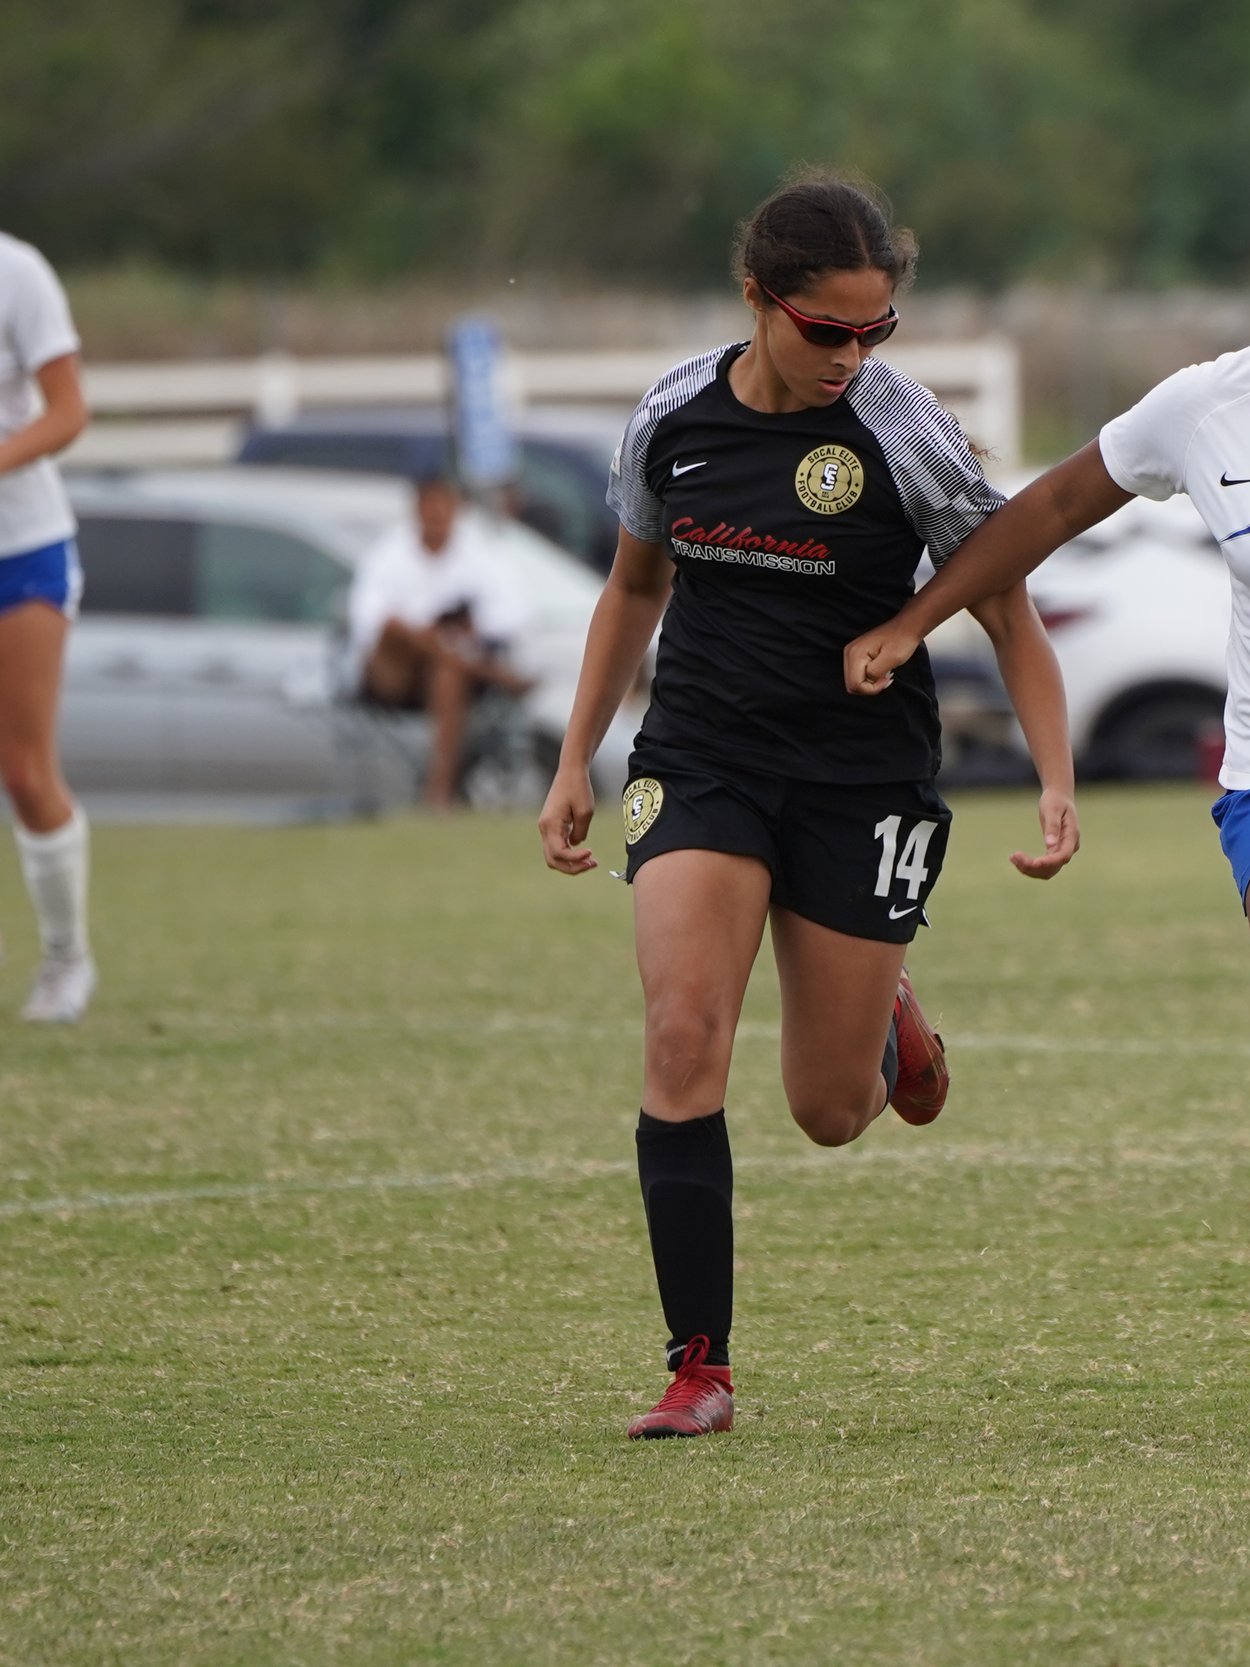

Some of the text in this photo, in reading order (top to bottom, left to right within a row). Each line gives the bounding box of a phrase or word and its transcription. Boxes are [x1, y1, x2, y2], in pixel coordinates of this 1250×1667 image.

[807, 447, 860, 472] SOCAL ELITE
[797, 480, 858, 513] FOOTBALL CLUB
[671, 516, 832, 559] California
[671, 537, 836, 575] TRANSMISSION
[874, 814, 939, 900] 14
